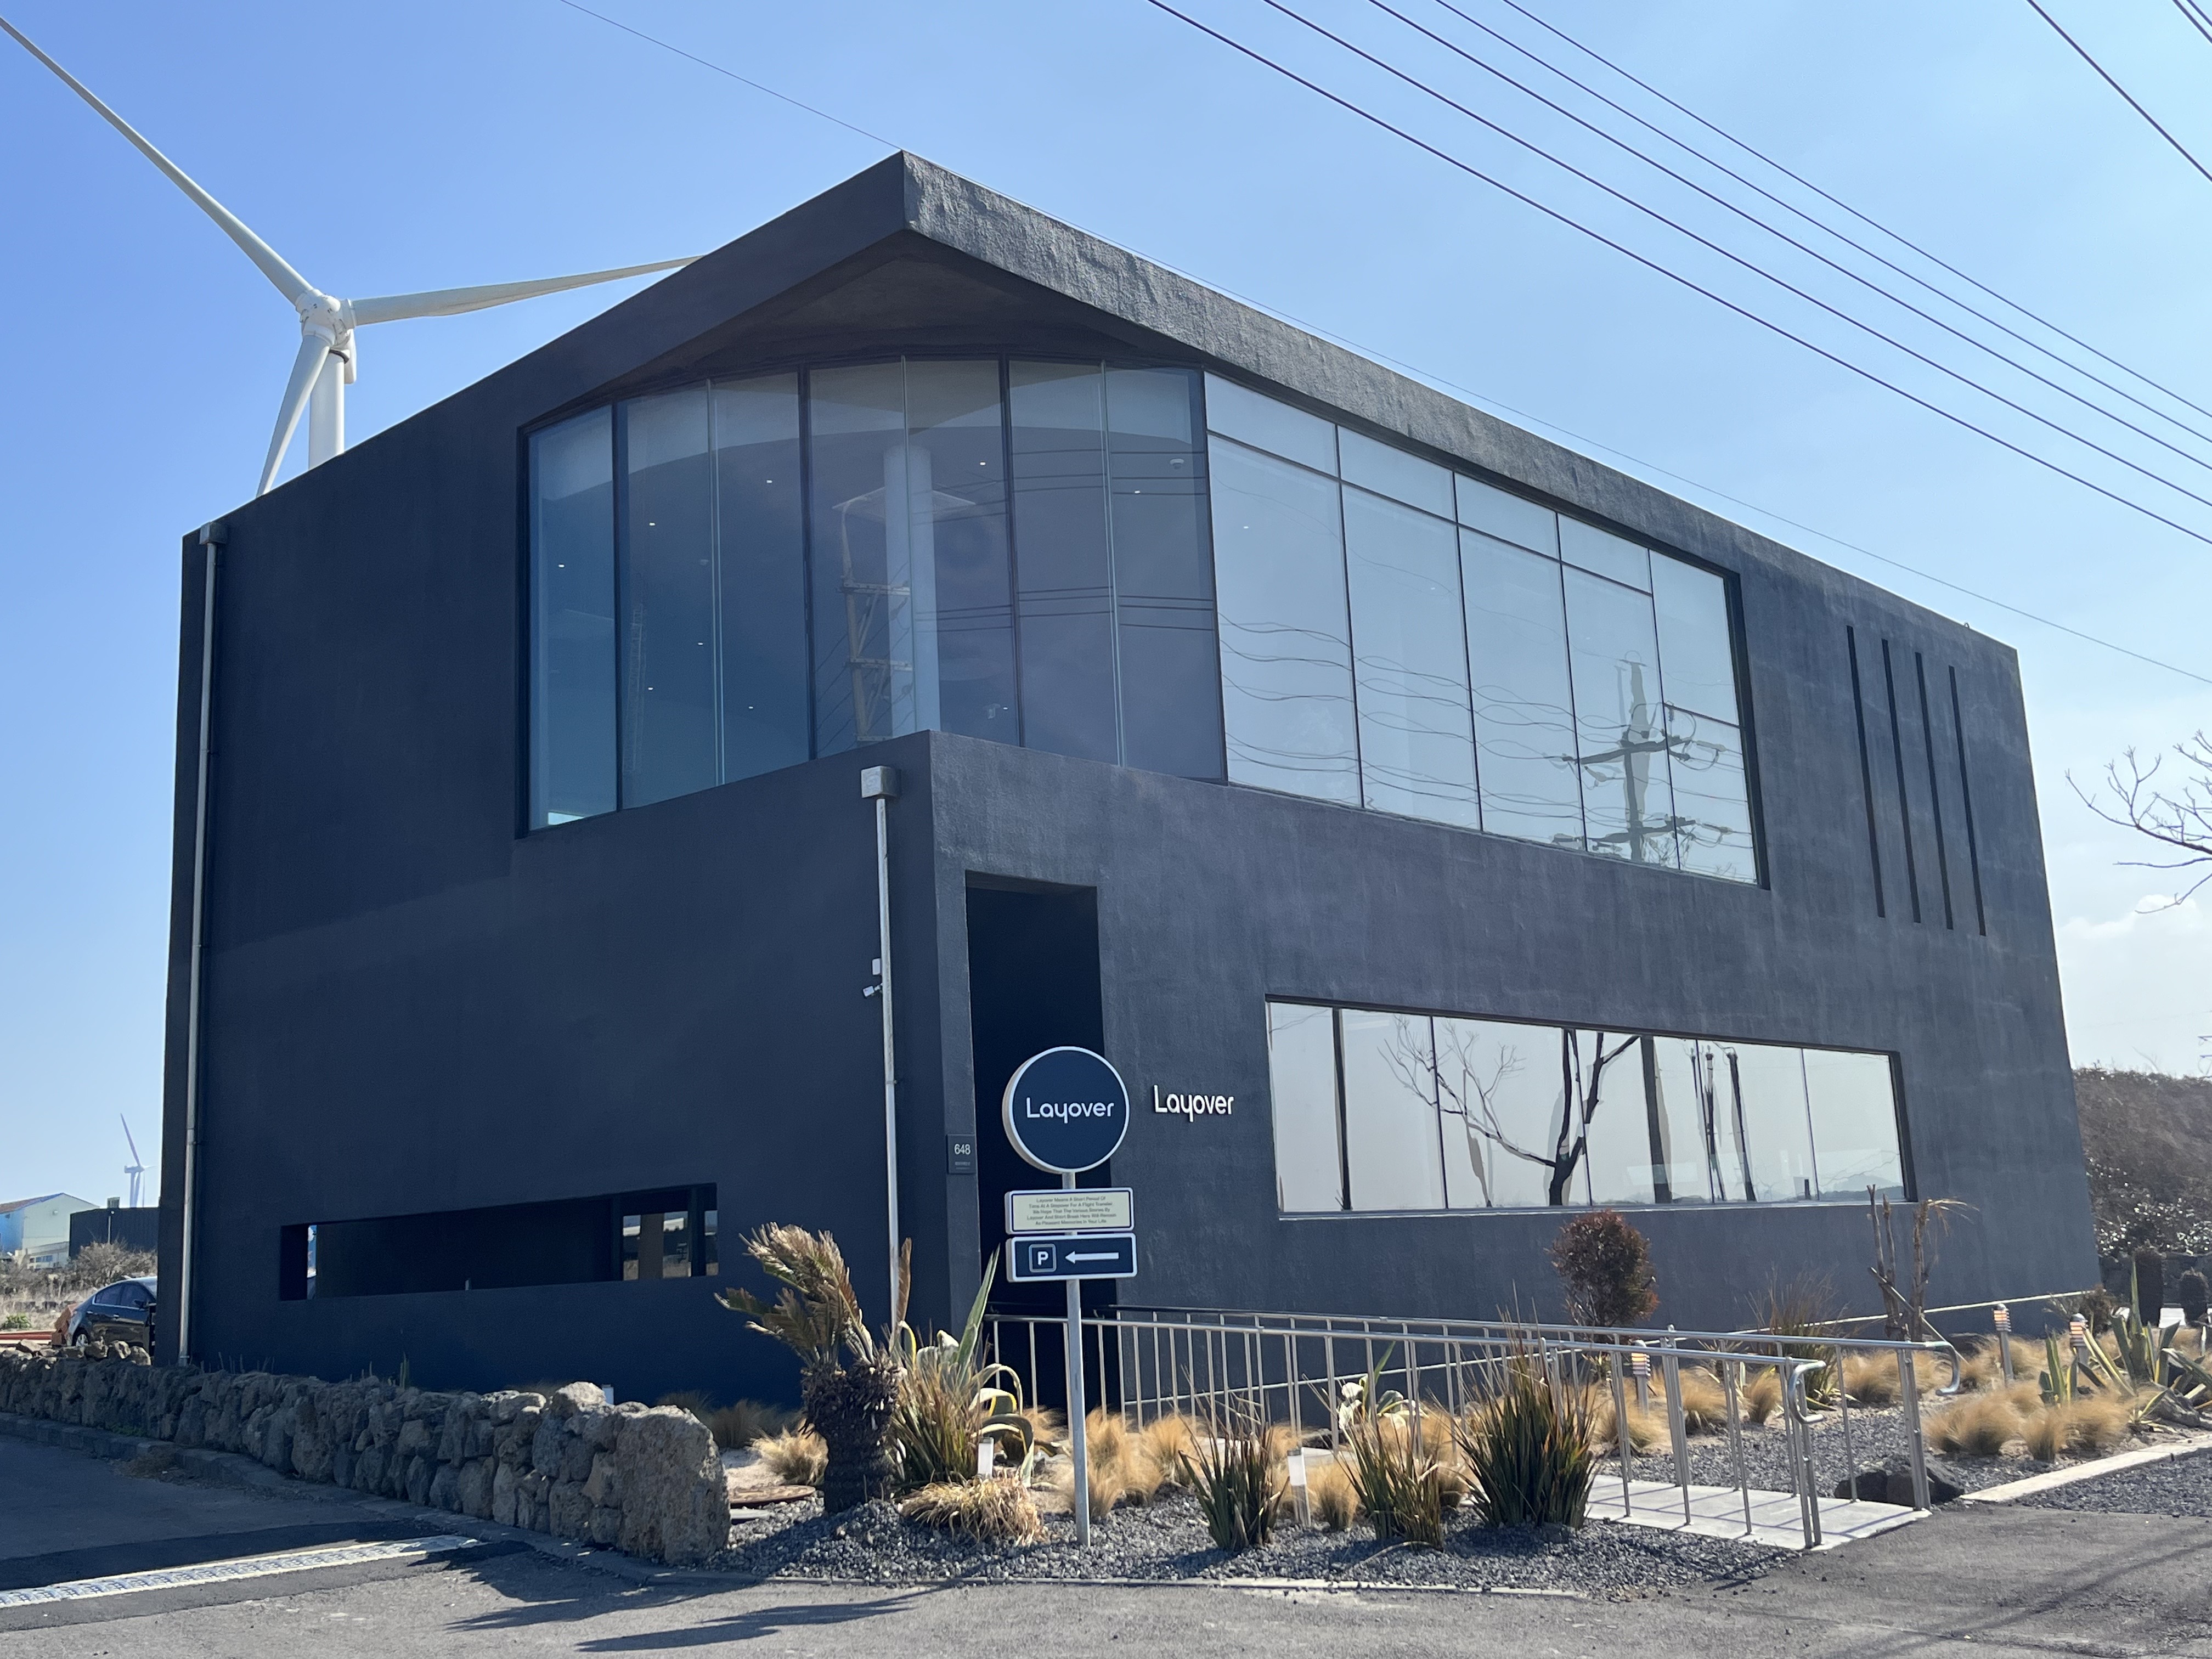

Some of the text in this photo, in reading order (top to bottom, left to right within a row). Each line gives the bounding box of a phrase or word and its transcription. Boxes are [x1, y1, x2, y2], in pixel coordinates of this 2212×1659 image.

[1026, 1097, 1114, 1124] Layover
[1154, 1085, 1234, 1122] Layover
[955, 1144, 970, 1155] 648
[1037, 1251, 1048, 1266] P
